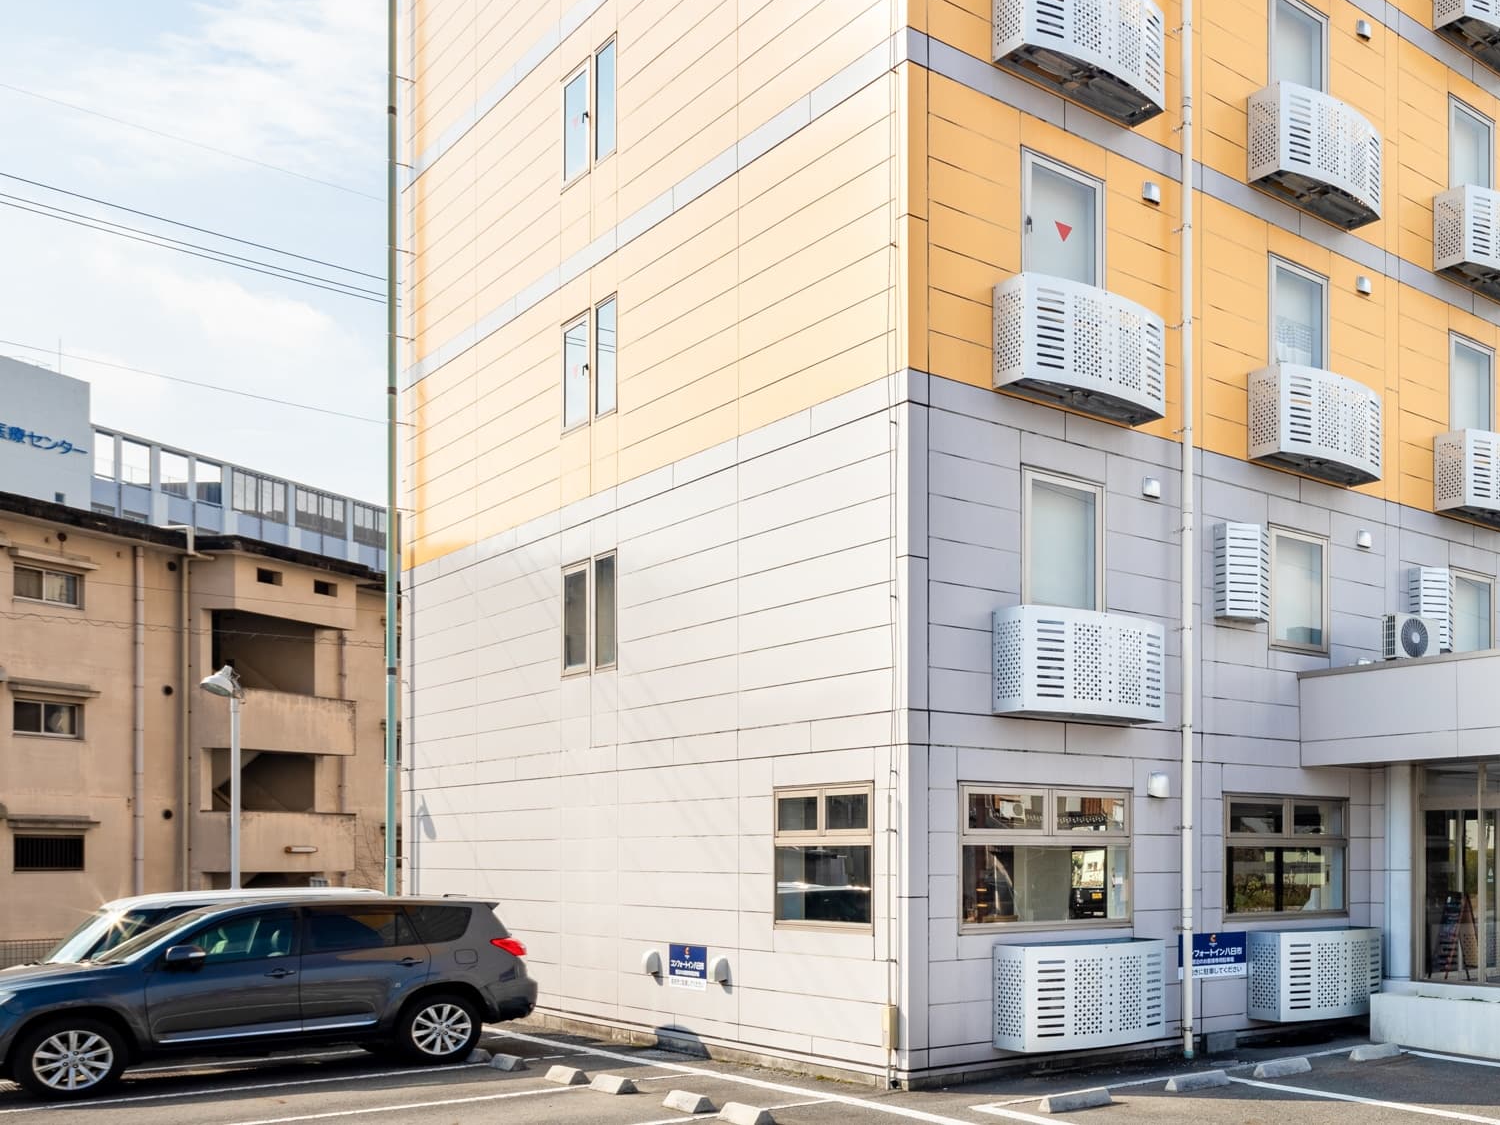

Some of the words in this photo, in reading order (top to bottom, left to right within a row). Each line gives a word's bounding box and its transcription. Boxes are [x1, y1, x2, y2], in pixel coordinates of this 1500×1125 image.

[1192, 947, 1242, 957] フォートイン八日市
